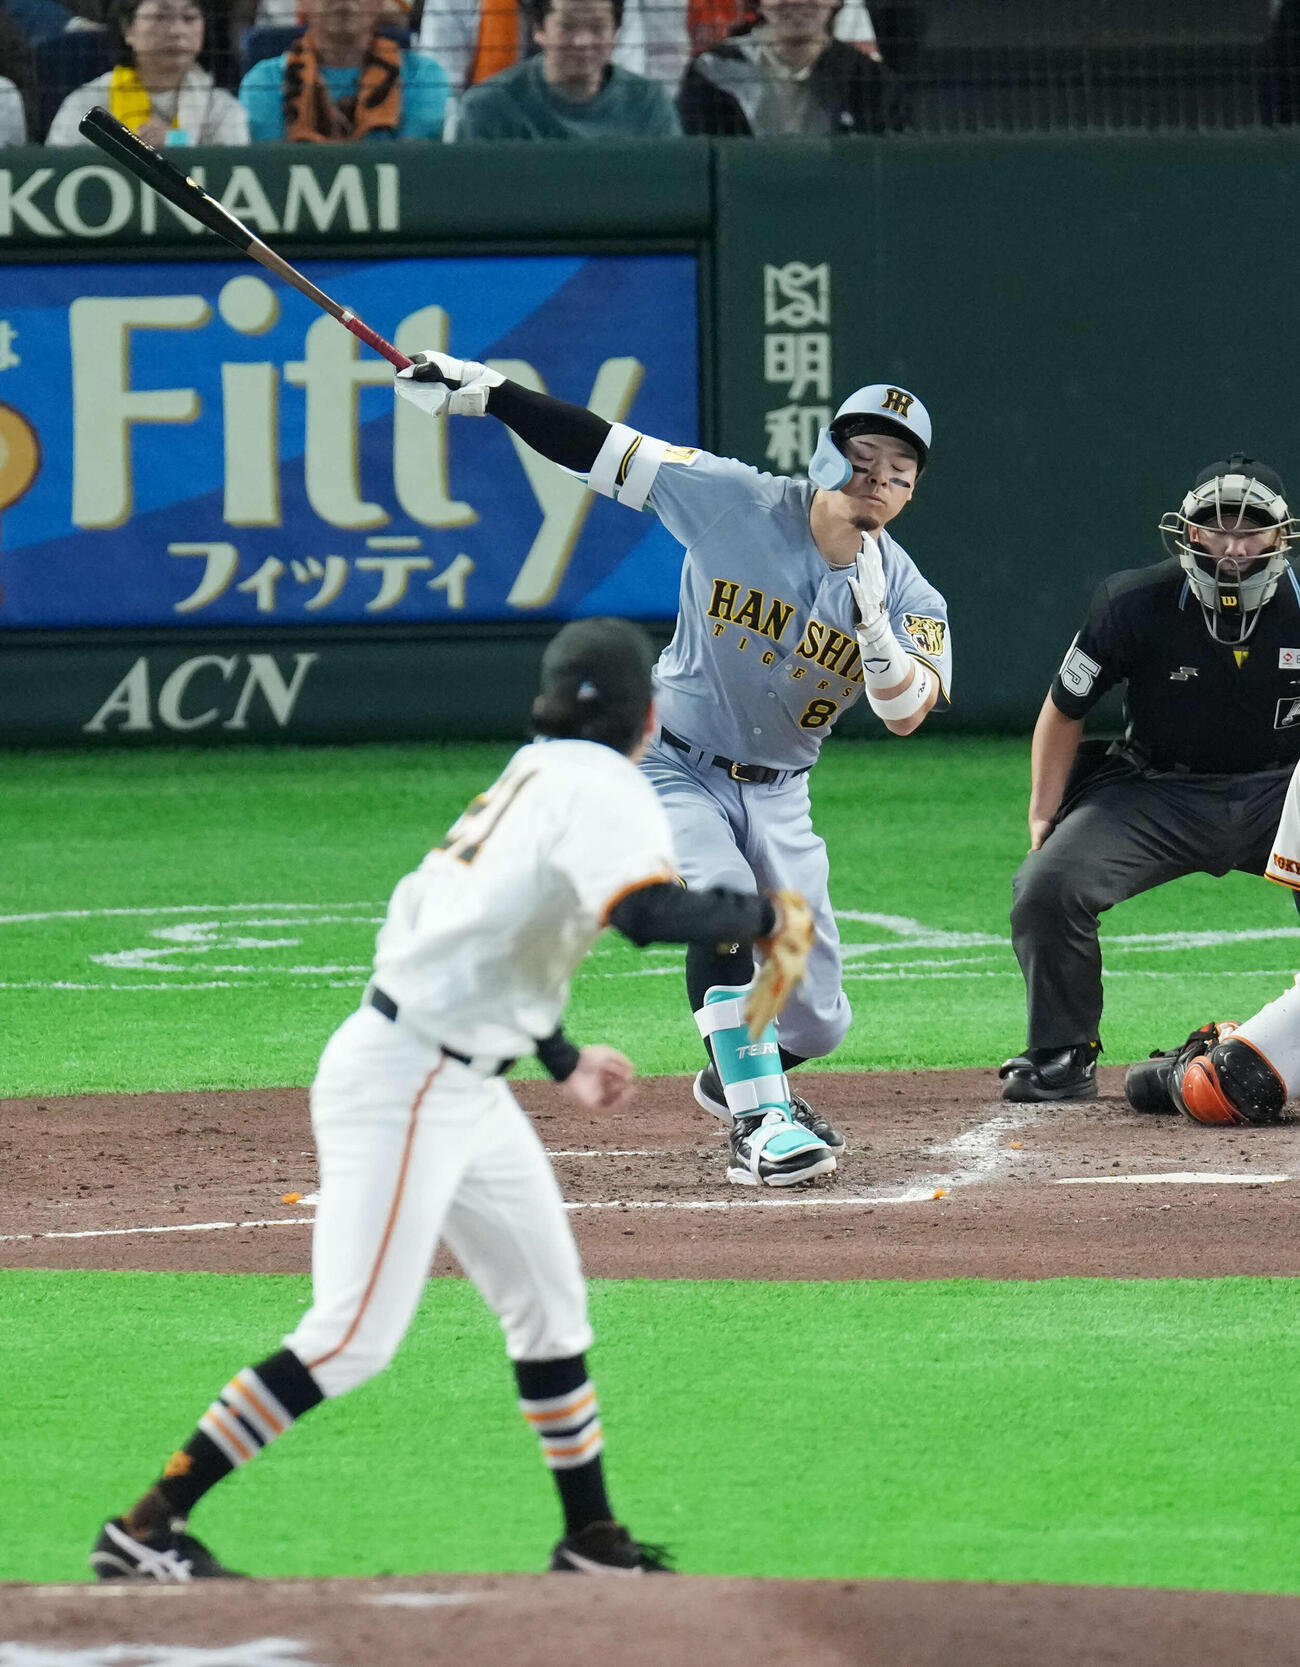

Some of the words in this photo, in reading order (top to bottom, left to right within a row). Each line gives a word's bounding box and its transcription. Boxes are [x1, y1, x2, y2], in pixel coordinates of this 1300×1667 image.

[0, 164, 399, 236] KONAMI
[70, 275, 645, 608] Fitty
[764, 332, 832, 479] 明和
[167, 536, 475, 611] フィッティ
[83, 653, 318, 732] ACN
[1059, 632, 1101, 697] 5
[799, 697, 839, 729] 8
[729, 942, 740, 954] 8
